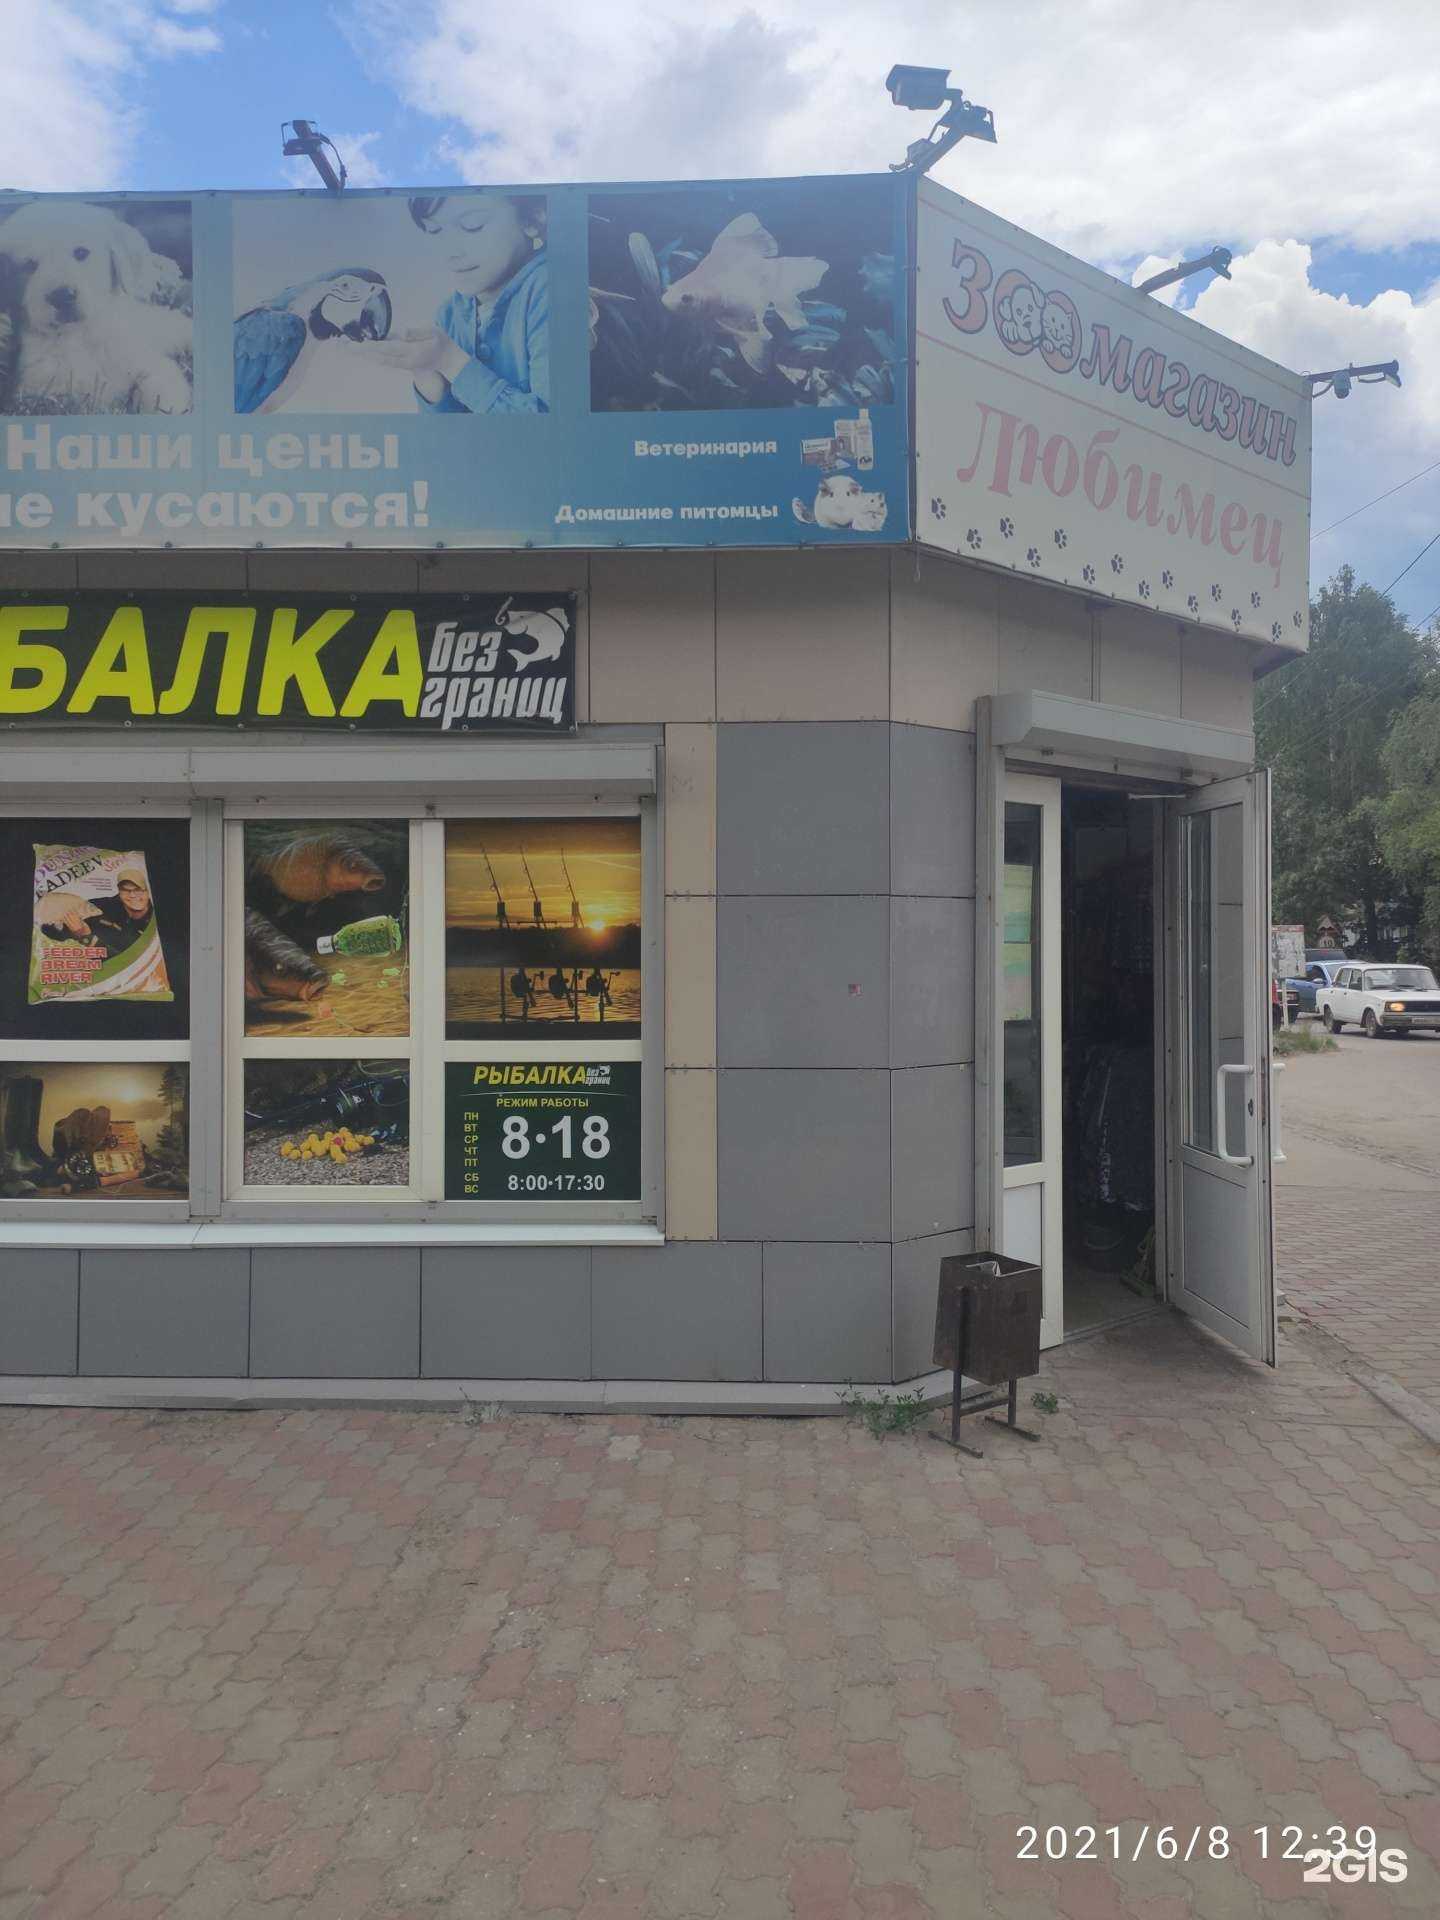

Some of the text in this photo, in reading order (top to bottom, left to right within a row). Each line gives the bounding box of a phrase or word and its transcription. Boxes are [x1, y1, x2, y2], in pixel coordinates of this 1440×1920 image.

[7, 424, 399, 477] Наши цены
[634, 440, 778, 459] Ветеринария
[956, 401, 1284, 589] Любимец
[77, 481, 429, 537] кусаются!
[554, 504, 779, 524] Домашние питомцы
[427, 621, 503, 673] без
[0, 605, 424, 718] БАЛКА
[420, 677, 568, 731] границ
[42, 946, 107, 958] FEEDER
[41, 959, 102, 971] BREAM
[41, 971, 92, 984] RIVER
[473, 1065, 586, 1085] РЫБАЛКА
[496, 1098, 589, 1108] РЕЖИМ РАБОТЫ
[464, 1112, 479, 1121] ПН
[464, 1124, 478, 1132] ВТ
[464, 1135, 479, 1144] СР
[464, 1147, 478, 1155] ЧТ
[464, 1159, 479, 1167] ПТ
[464, 1173, 480, 1182] СБ
[464, 1185, 479, 1193] ВС
